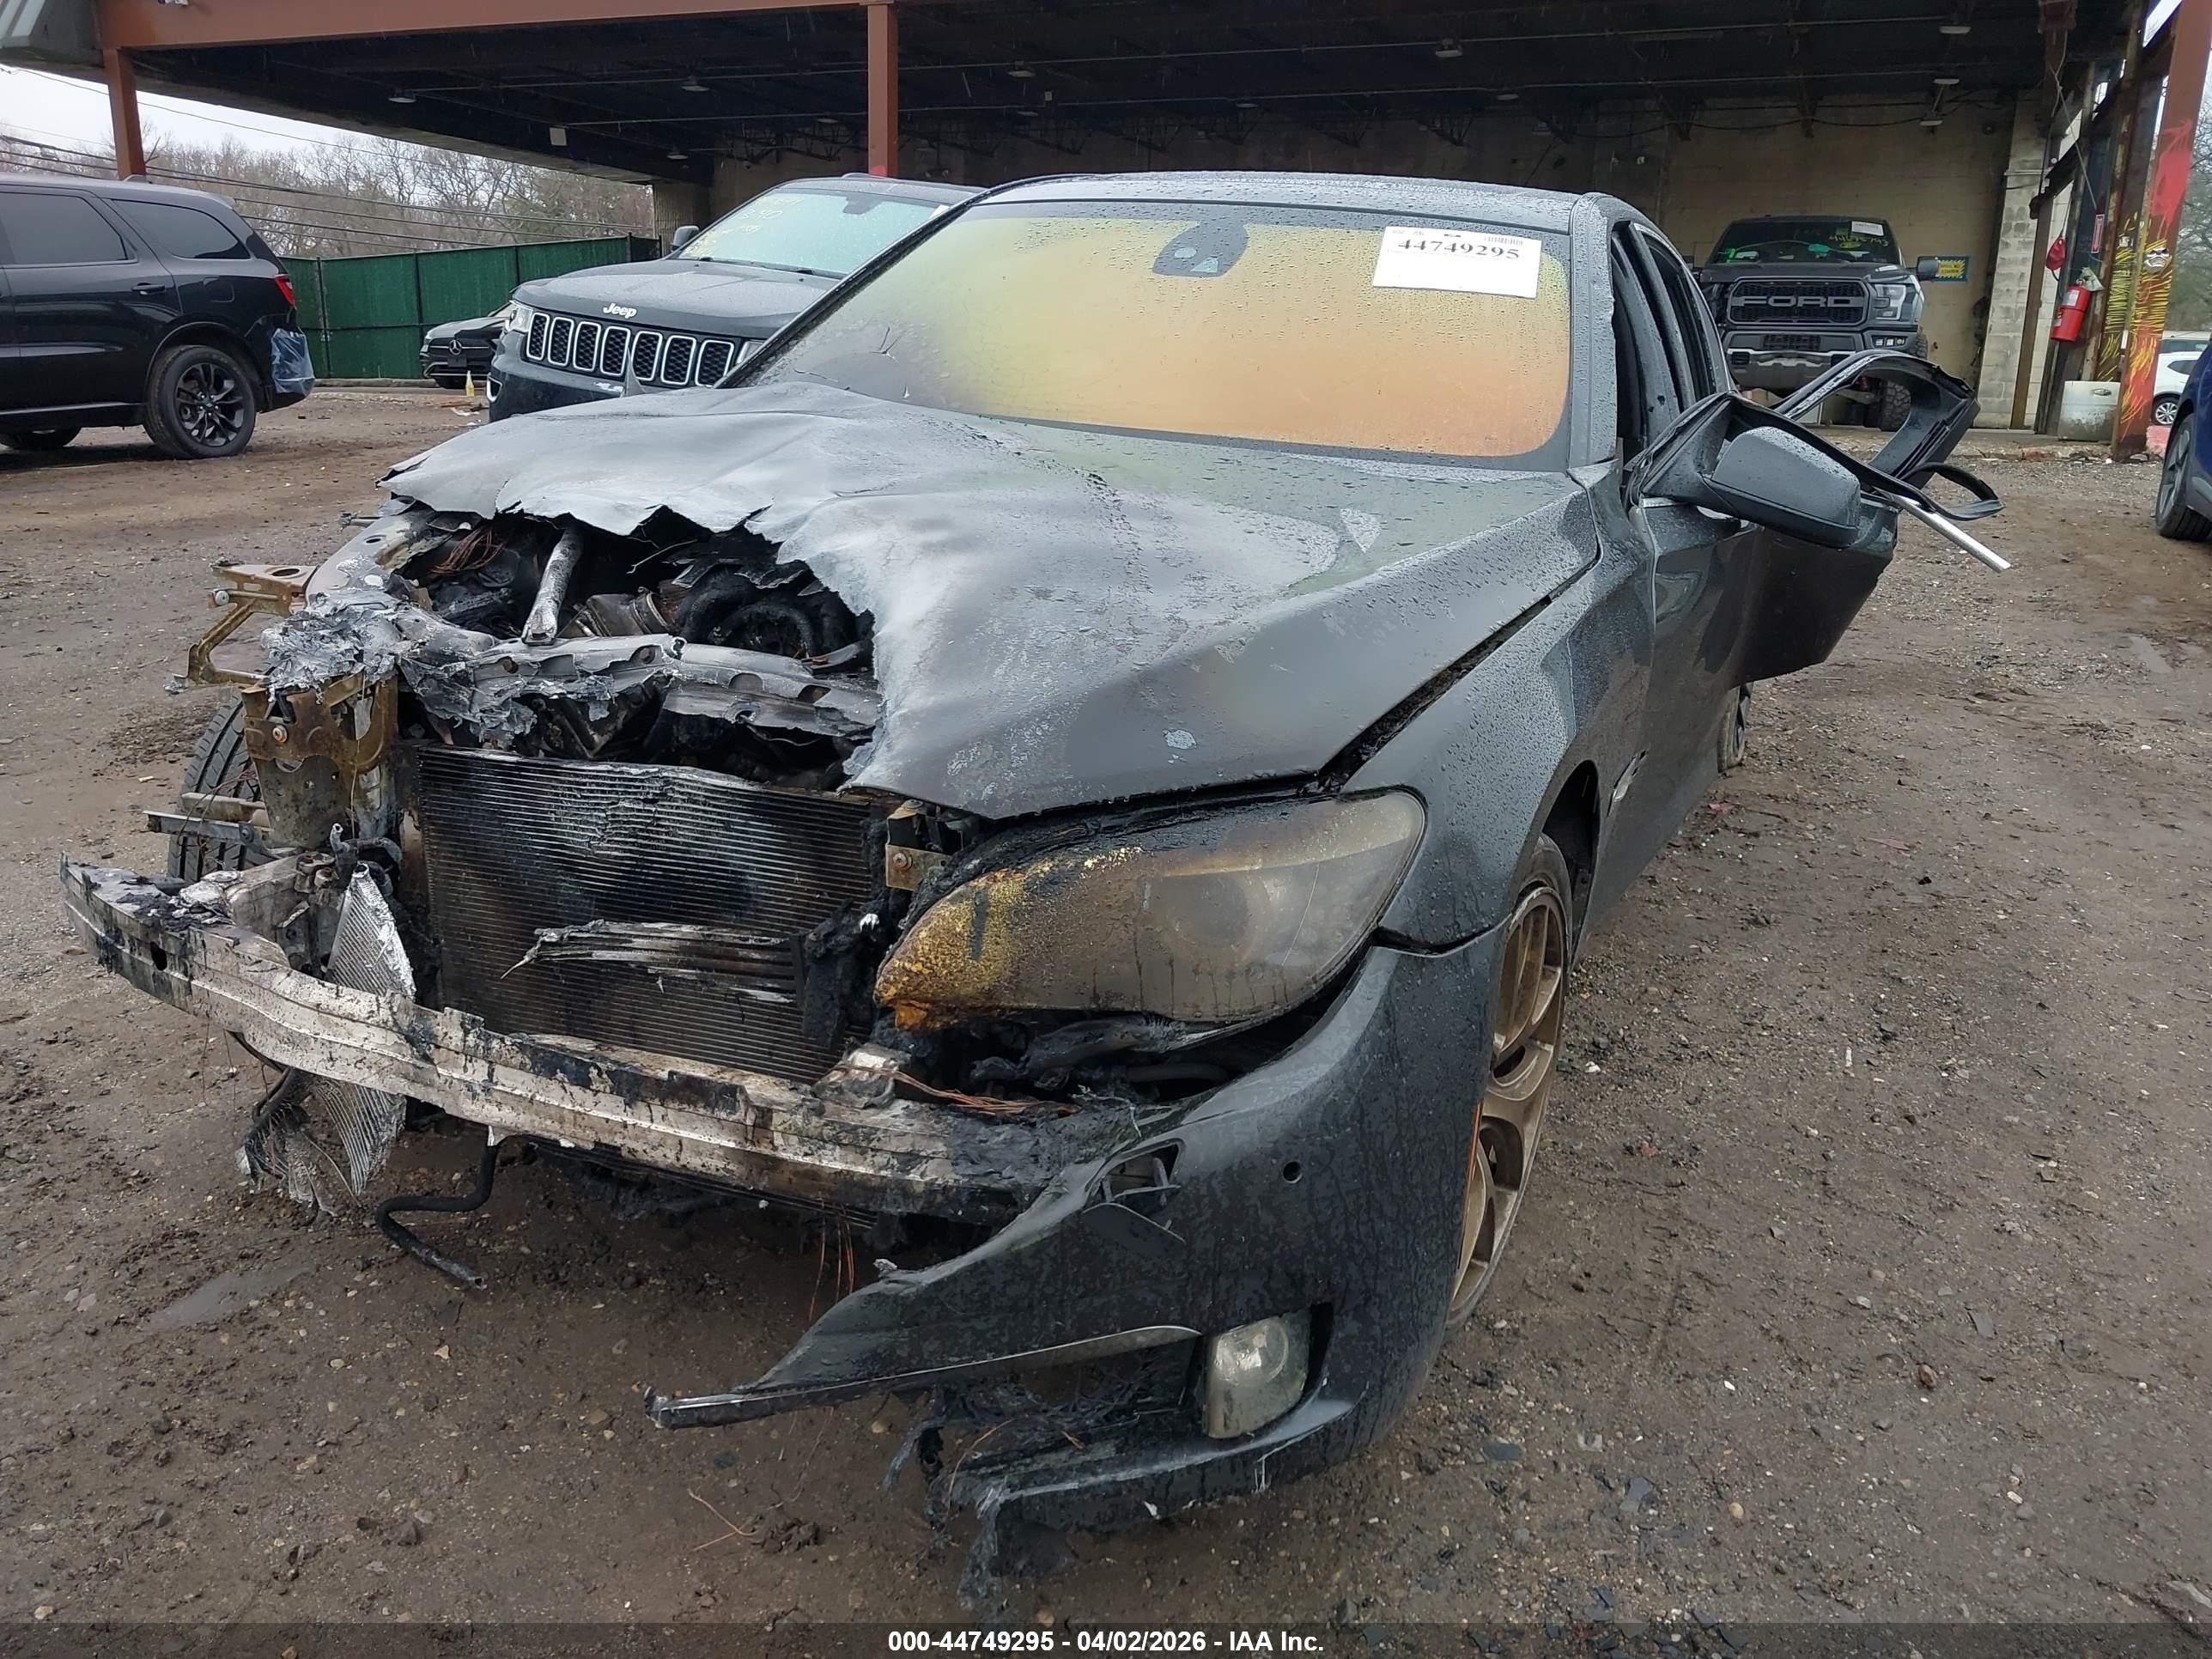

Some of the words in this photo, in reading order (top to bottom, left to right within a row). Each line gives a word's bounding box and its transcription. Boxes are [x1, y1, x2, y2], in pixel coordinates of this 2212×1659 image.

[1398, 239, 1520, 259] 44749295
[1731, 295, 1864, 307] FORD
[603, 302, 637, 319] Jeep
